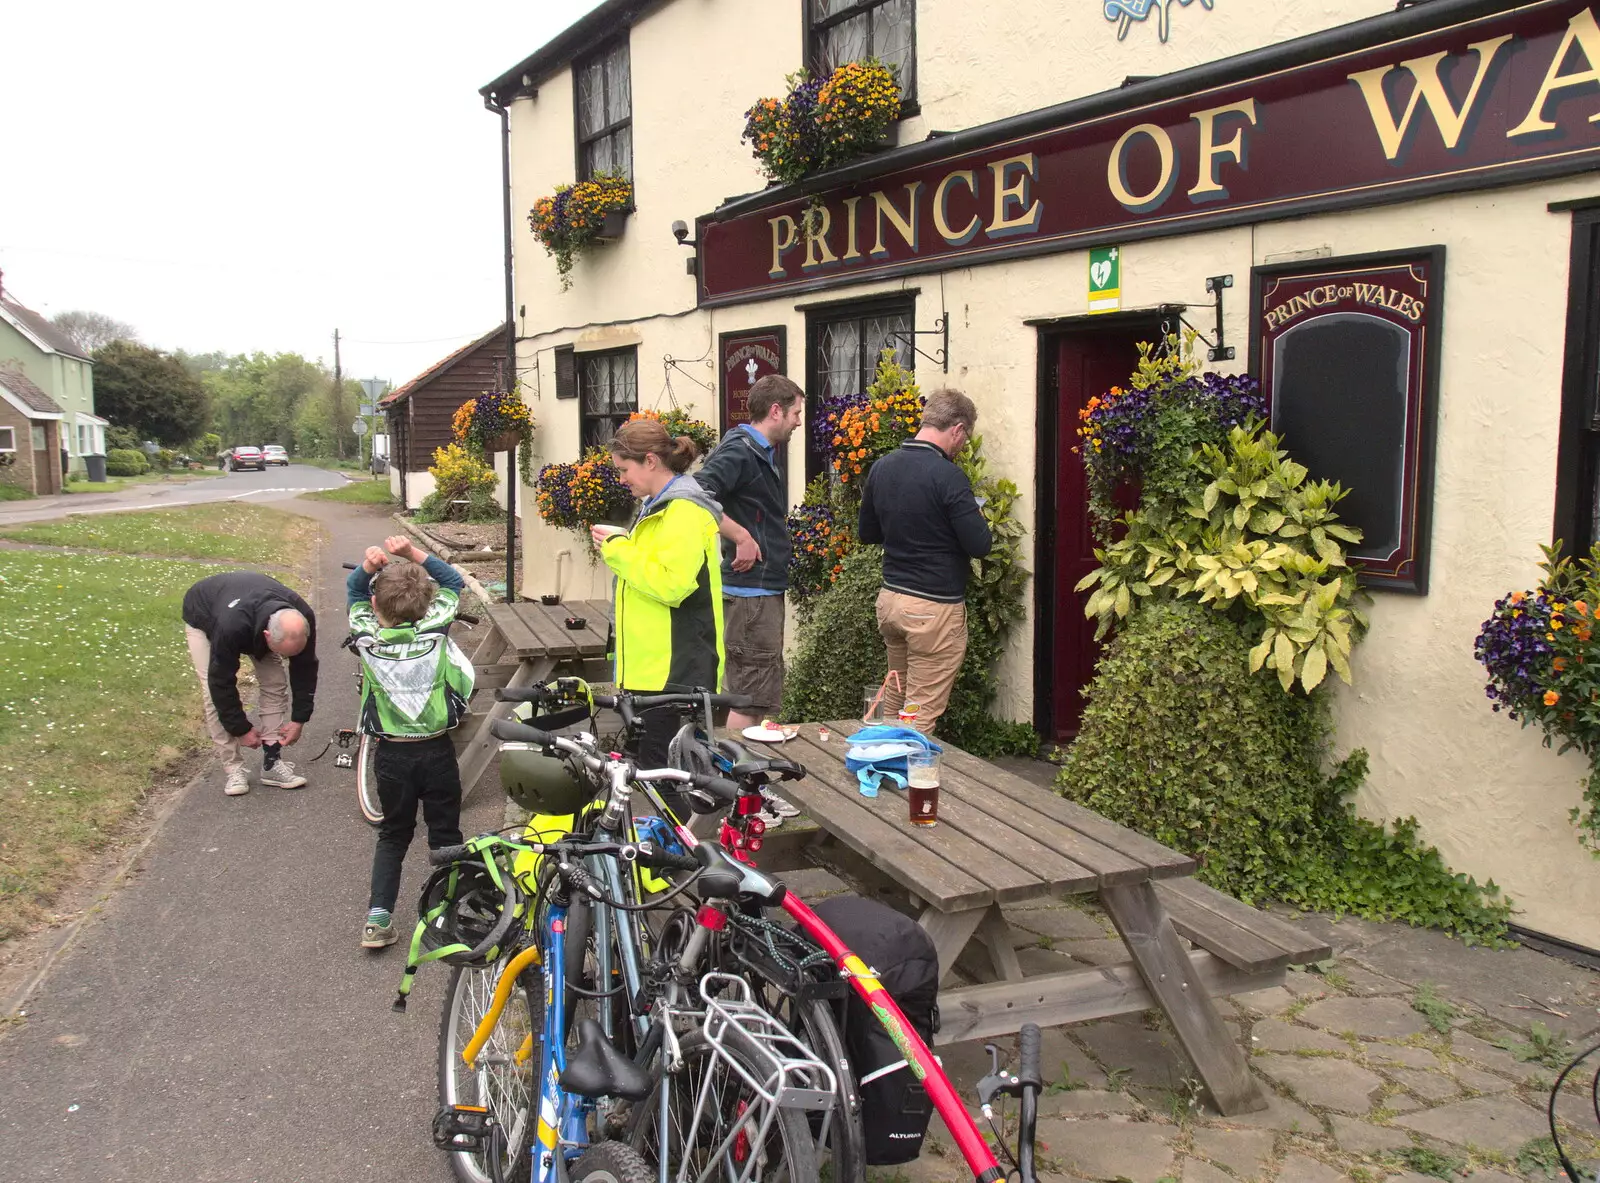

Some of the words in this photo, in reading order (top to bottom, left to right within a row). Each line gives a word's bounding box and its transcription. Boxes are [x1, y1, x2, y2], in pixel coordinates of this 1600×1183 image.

[767, 152, 1041, 276] PRINCE
[1106, 98, 1258, 208] OF
[1263, 284, 1337, 332] PRINCE
[1337, 286, 1354, 299] OF
[1352, 282, 1425, 321] WALES
